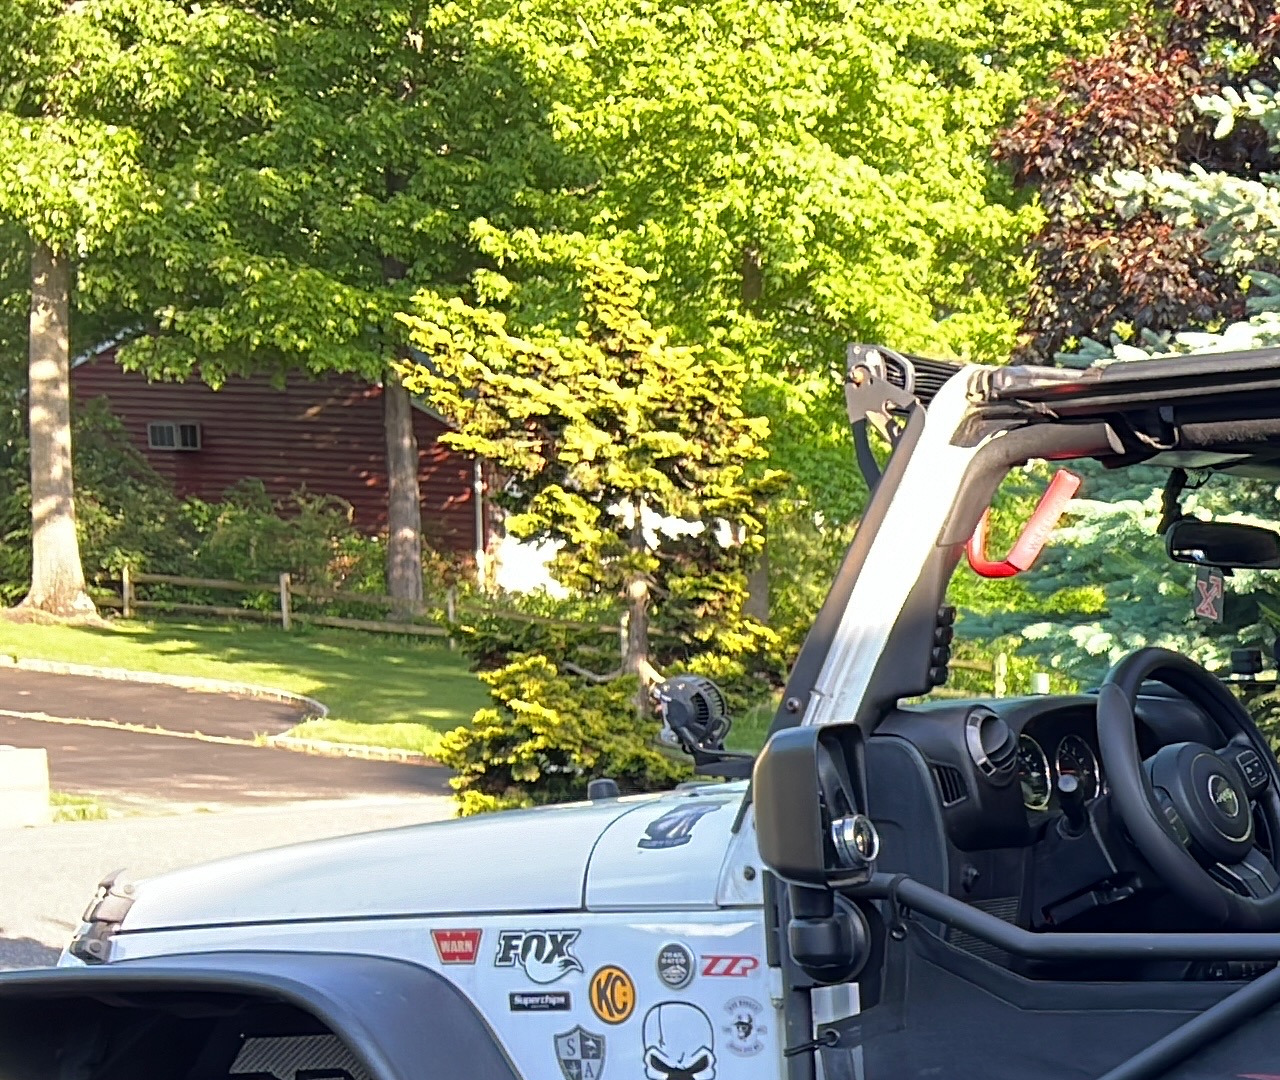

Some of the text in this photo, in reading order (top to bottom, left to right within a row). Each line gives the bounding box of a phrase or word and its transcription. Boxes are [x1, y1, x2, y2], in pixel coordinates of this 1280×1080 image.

[440, 940, 473, 953] WARN
[496, 931, 579, 966] FOX
[596, 971, 629, 1018] KC
[566, 1039, 576, 1056] S
[584, 1061, 595, 1079] A
